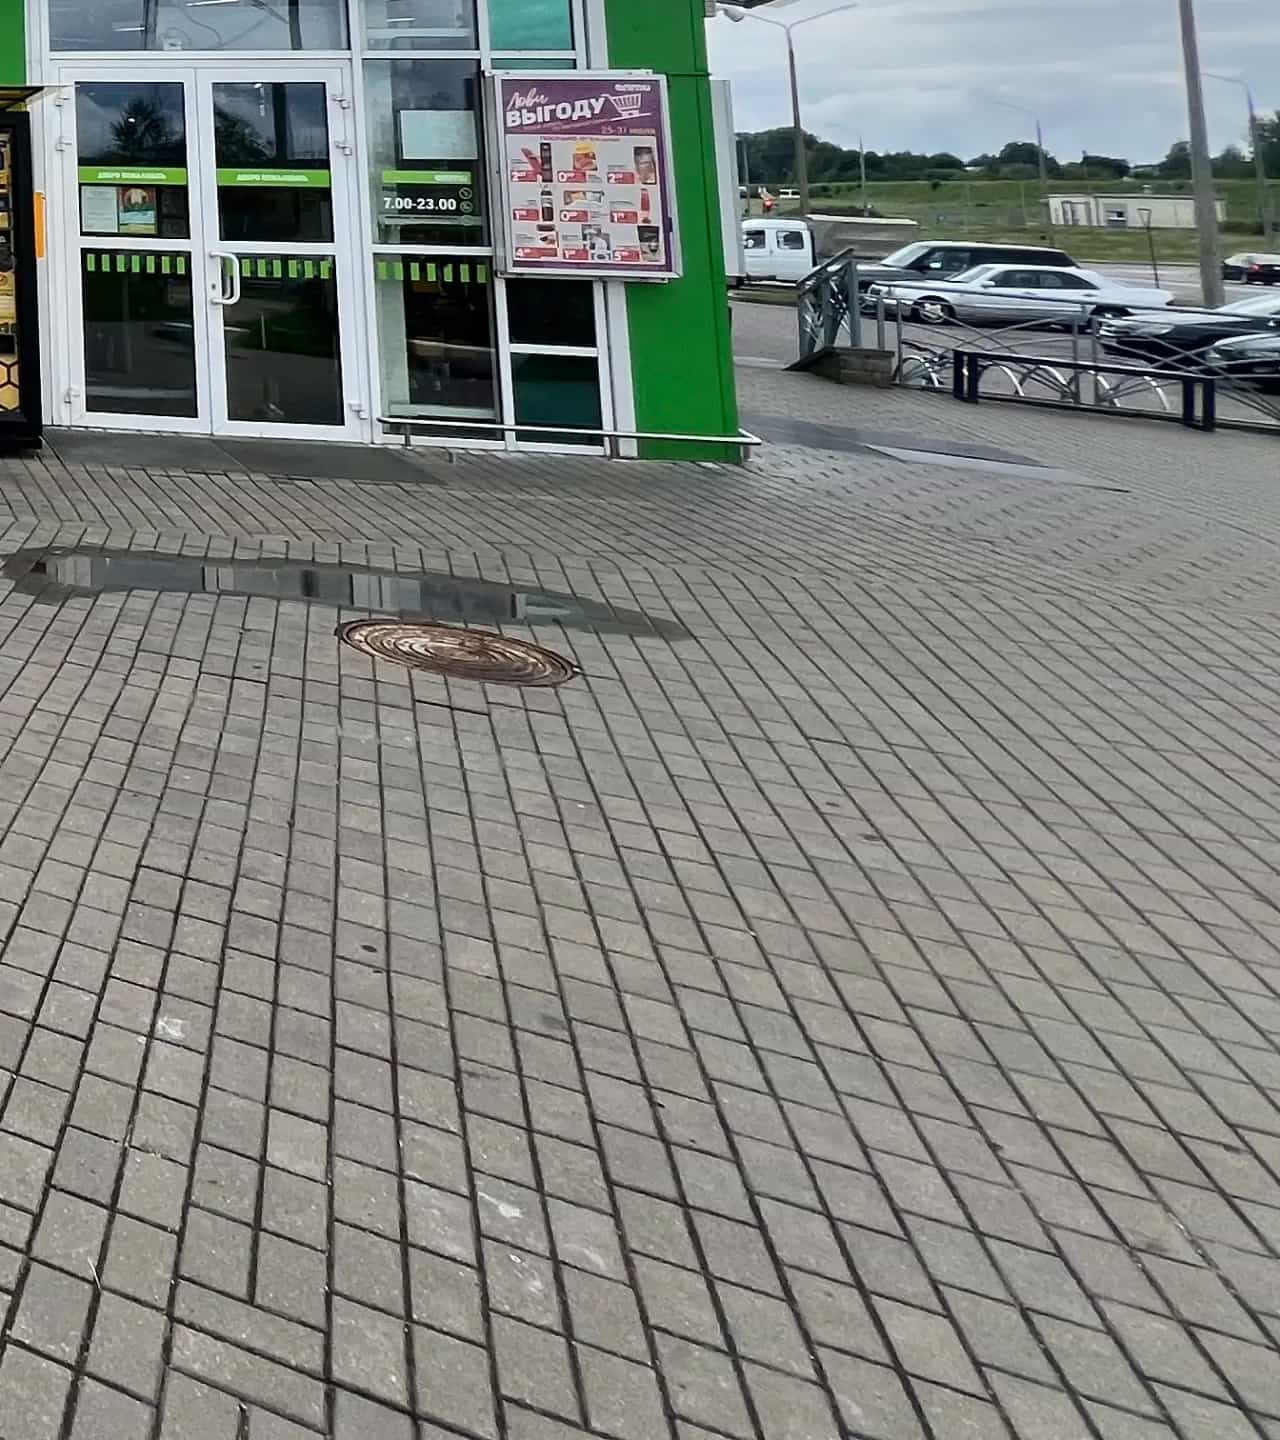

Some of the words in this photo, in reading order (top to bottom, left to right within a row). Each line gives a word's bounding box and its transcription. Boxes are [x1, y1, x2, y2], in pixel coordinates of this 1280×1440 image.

[507, 88, 549, 110] Лови
[506, 97, 606, 127] ВЫГОДУ
[383, 197, 457, 210] 7.00-23.00
